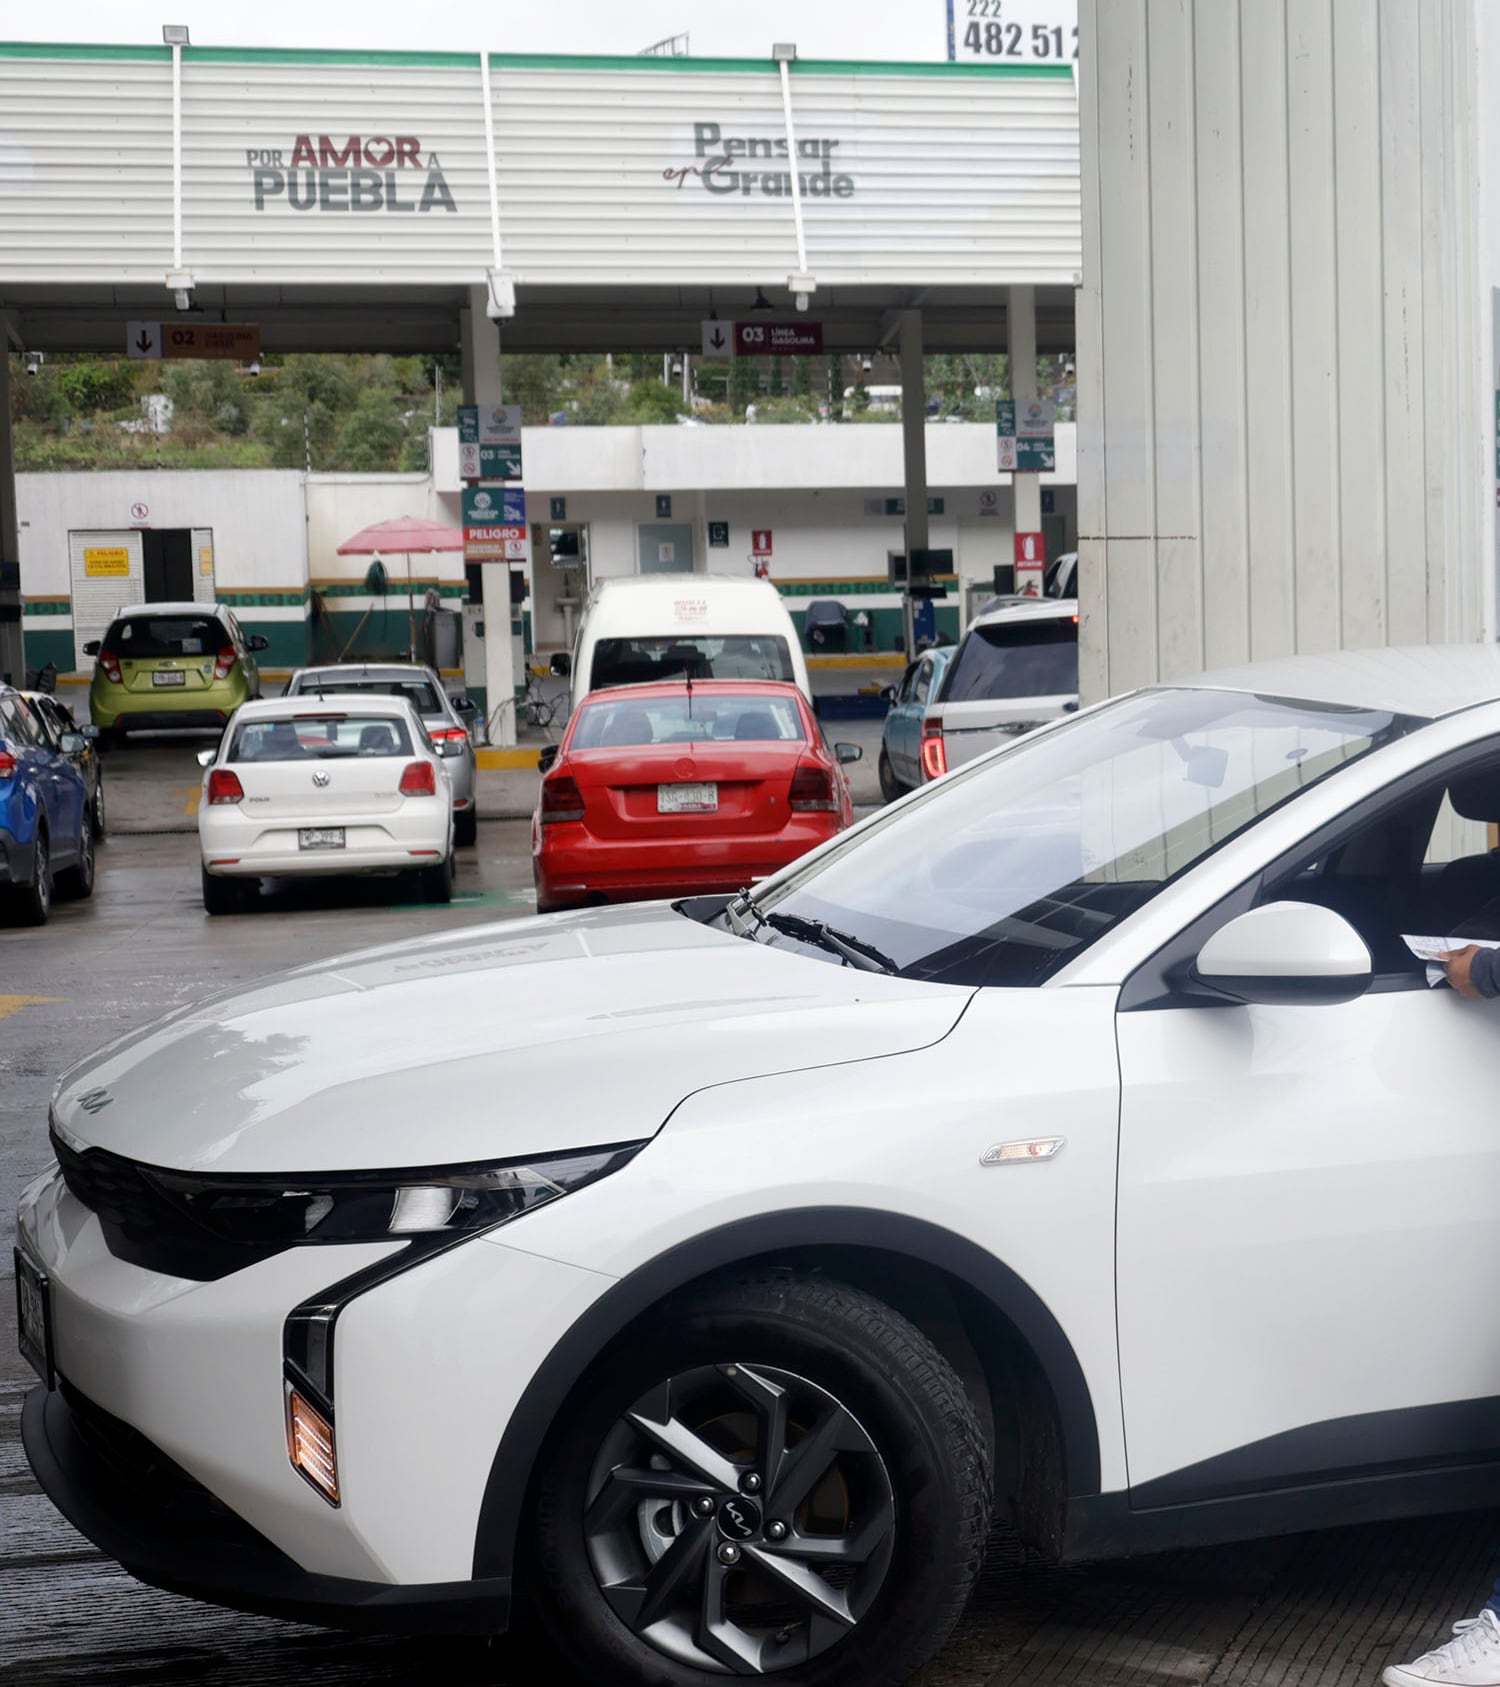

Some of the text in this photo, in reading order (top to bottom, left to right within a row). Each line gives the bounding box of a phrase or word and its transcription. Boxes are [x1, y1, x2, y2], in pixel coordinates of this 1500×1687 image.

[967, 0, 1001, 17] 222
[964, 20, 1023, 56] 482
[1031, 24, 1063, 58] 51
[694, 122, 840, 158] Pensar
[246, 134, 441, 169] POR AMOR A
[701, 156, 855, 198] Grande
[253, 169, 458, 212] PUEBLA
[172, 330, 195, 345] 02
[742, 327, 765, 342] 03
[480, 450, 495, 460] 03
[1016, 442, 1030, 452] 04
[469, 528, 520, 540] PELIGRO
